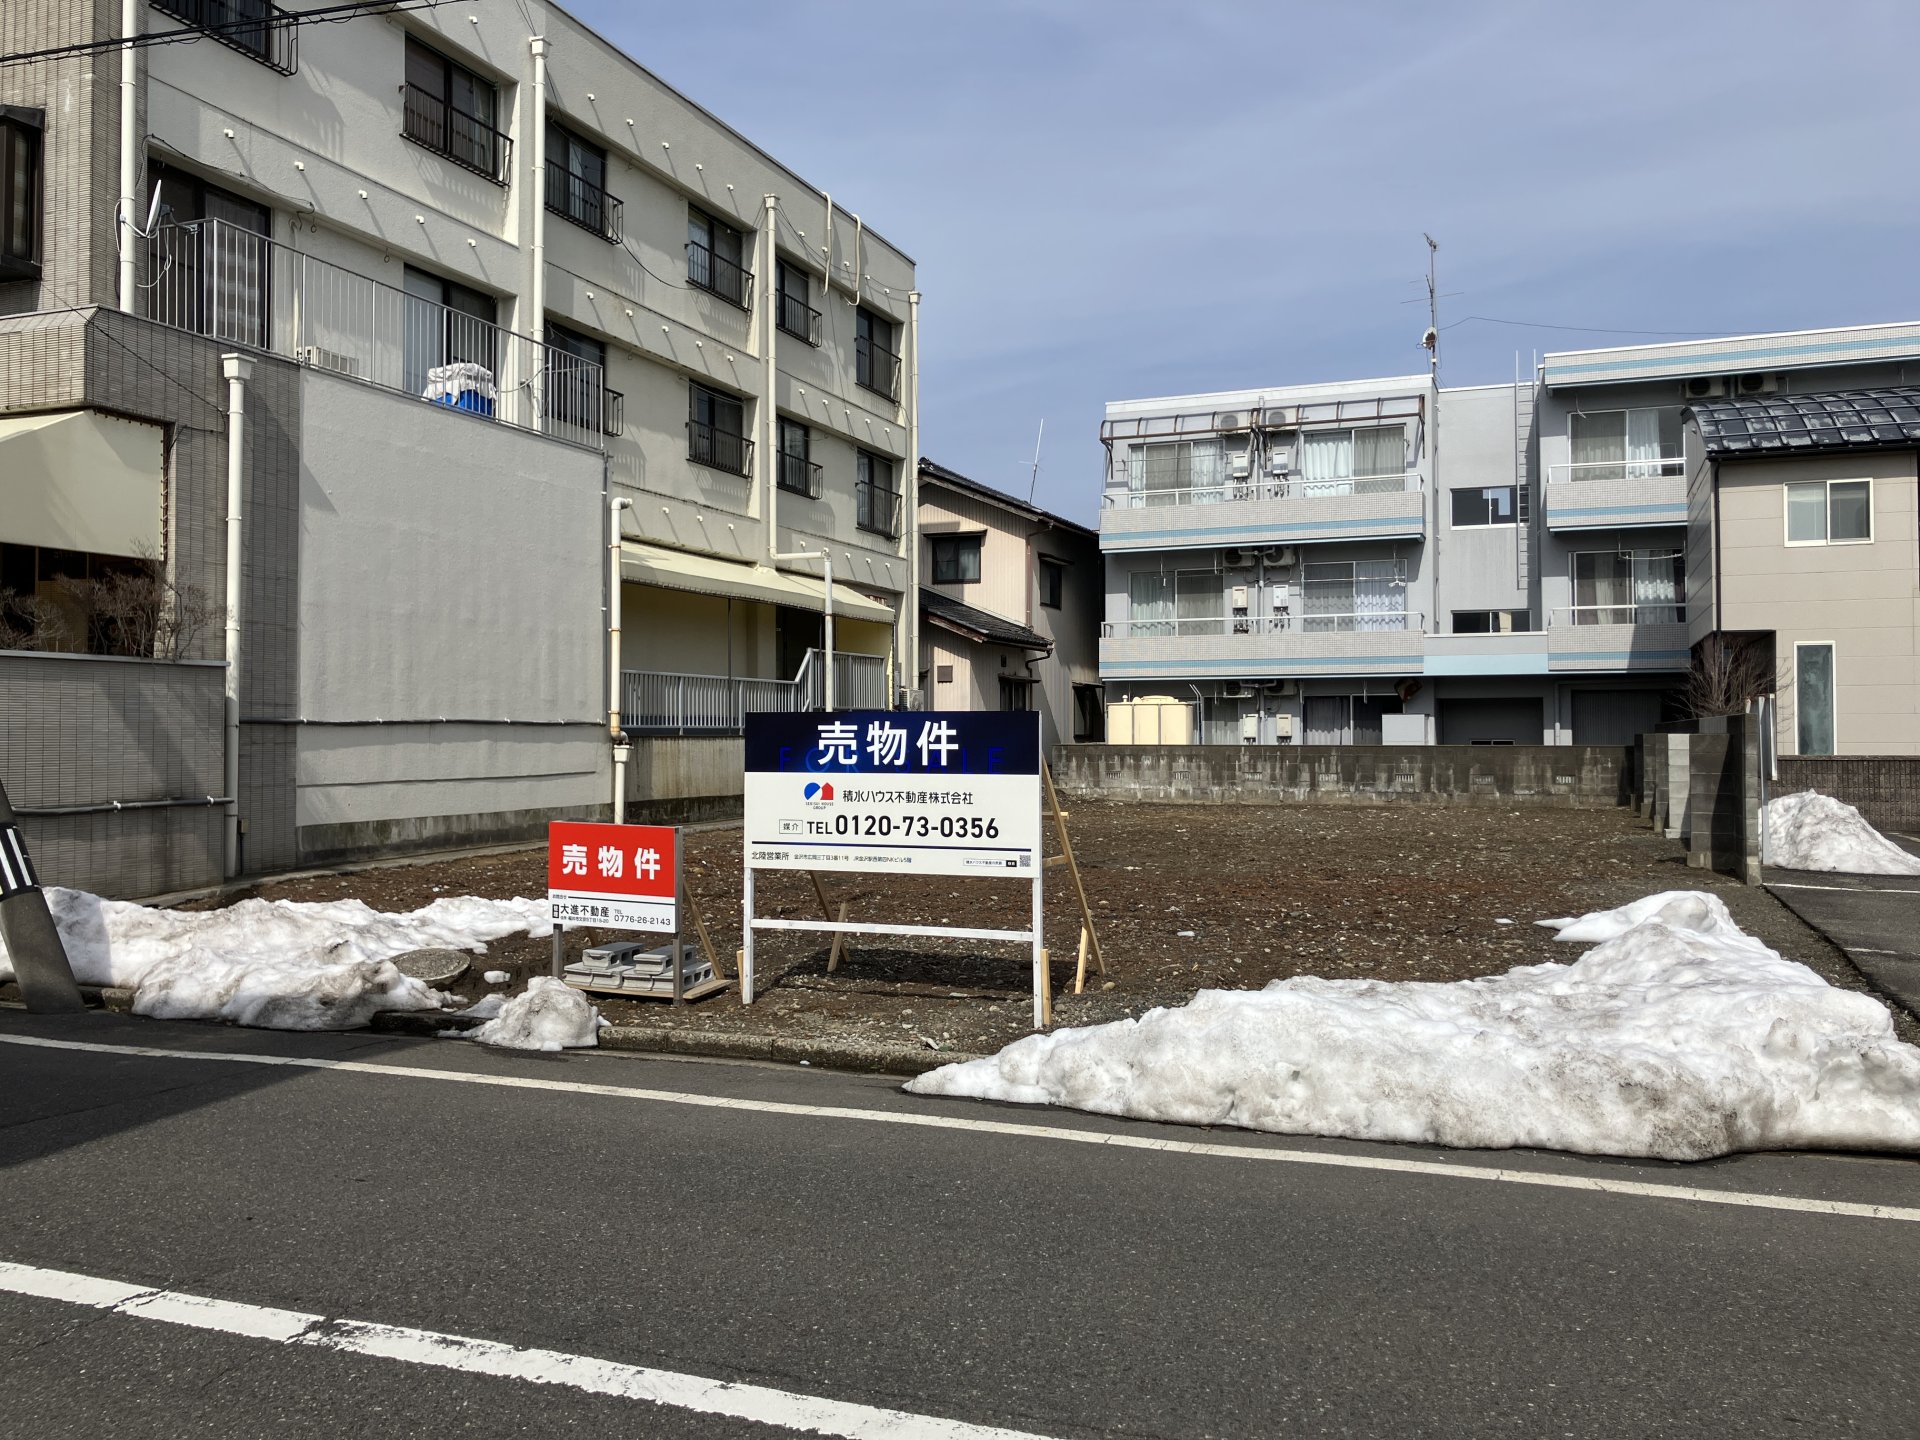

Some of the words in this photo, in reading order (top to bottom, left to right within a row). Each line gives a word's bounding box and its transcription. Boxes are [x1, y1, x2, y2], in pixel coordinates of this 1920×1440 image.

[818, 721, 959, 766] 売物件
[842, 790, 974, 805] 積水ハウス不動産株式会社
[782, 821, 801, 832] 媒介
[806, 821, 834, 835] TEL
[835, 815, 999, 838] 0120-73-0356
[562, 844, 660, 879] 売物件
[751, 851, 790, 861] 北陸営業所
[560, 904, 609, 917] 大進不動産
[614, 914, 671, 925] 0776-26-2143
